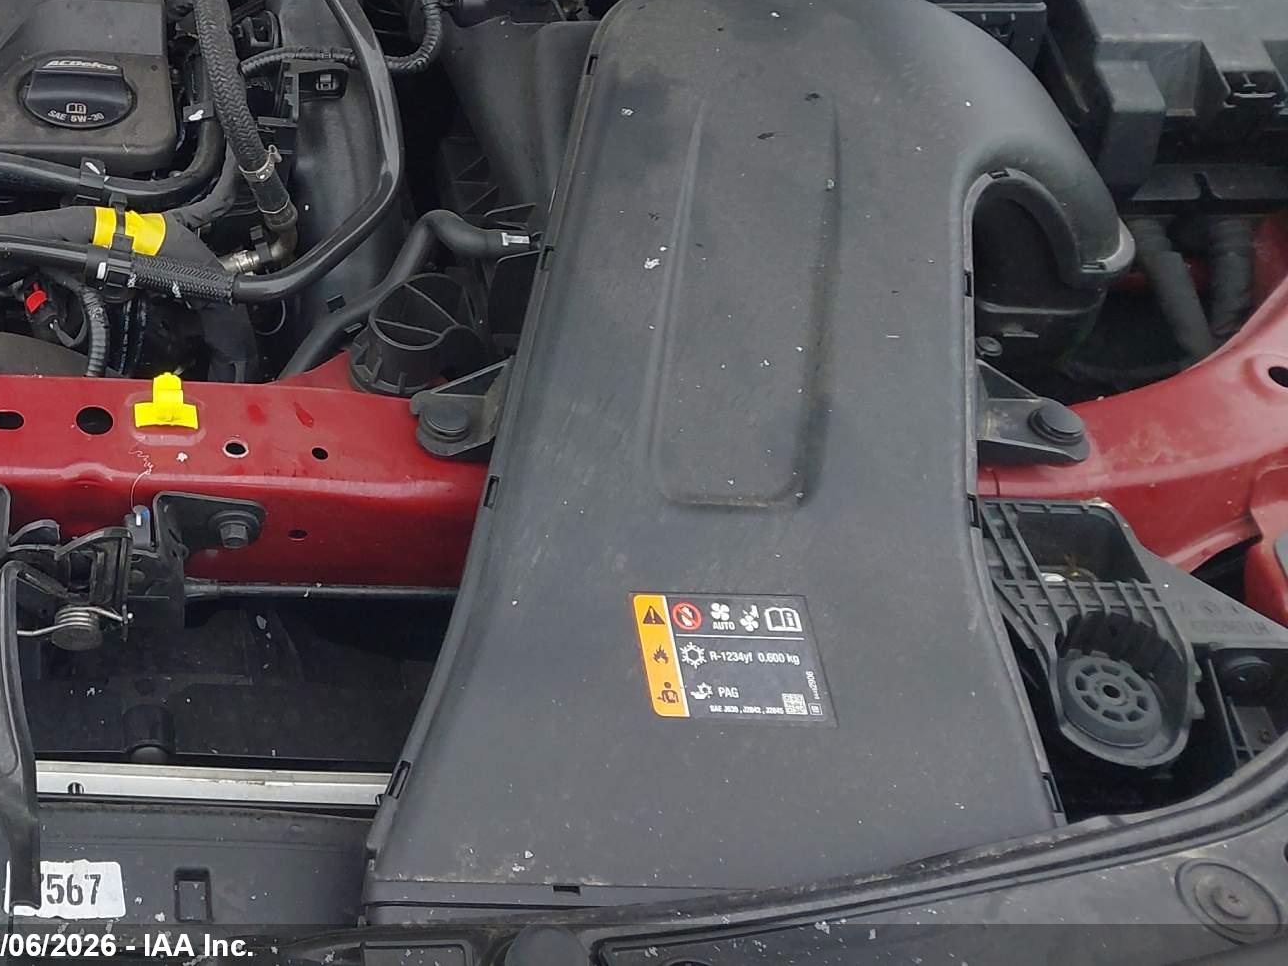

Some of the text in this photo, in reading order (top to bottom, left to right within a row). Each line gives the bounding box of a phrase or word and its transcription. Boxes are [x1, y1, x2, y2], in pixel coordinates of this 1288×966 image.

[43, 60, 119, 71] ACDelco
[47, 110, 105, 123] SAE 5W-30
[712, 621, 736, 631] AUTO
[709, 650, 753, 664] R-1234yf
[786, 652, 800, 666] kg
[717, 686, 740, 699] PAG
[40, 873, 101, 906] 567
